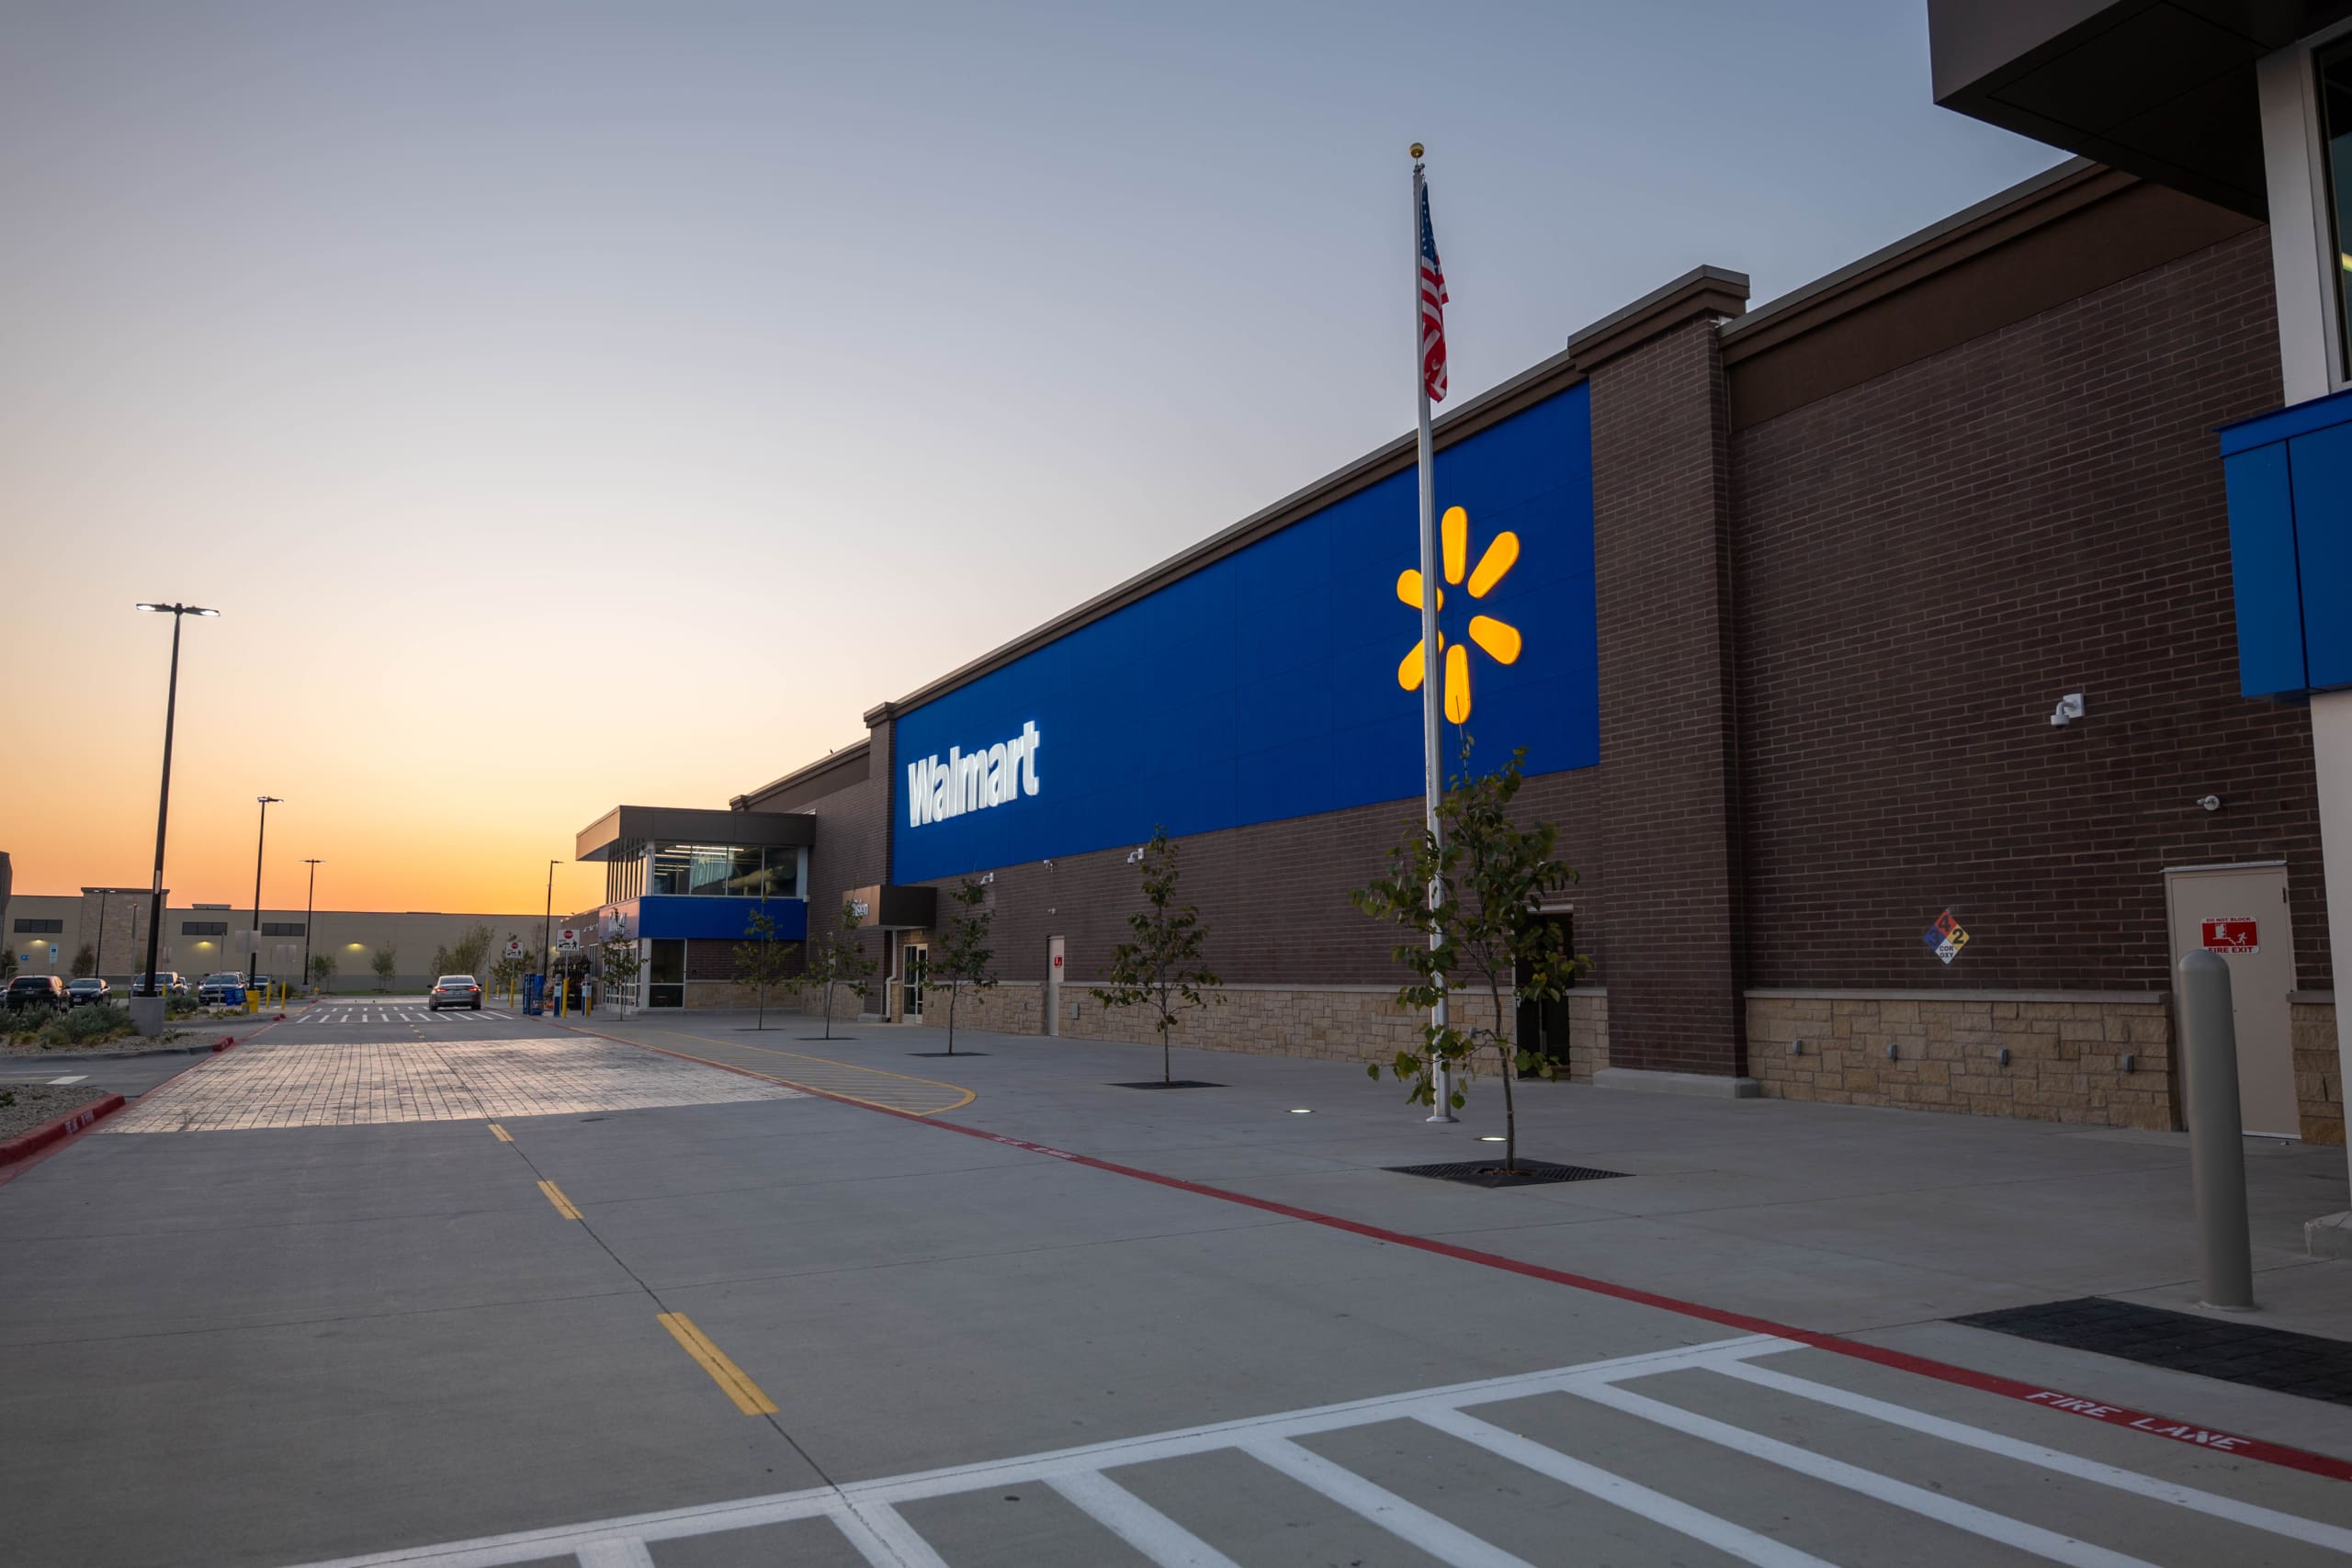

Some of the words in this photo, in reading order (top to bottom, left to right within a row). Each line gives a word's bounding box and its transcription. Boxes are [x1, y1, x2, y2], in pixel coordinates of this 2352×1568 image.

[908, 720, 1040, 828] Walmart
[1939, 916, 1951, 931] 4
[1952, 928, 1964, 944] 2
[2024, 1391, 2123, 1418] FIRE
[2128, 1417, 2251, 1450] LANE
